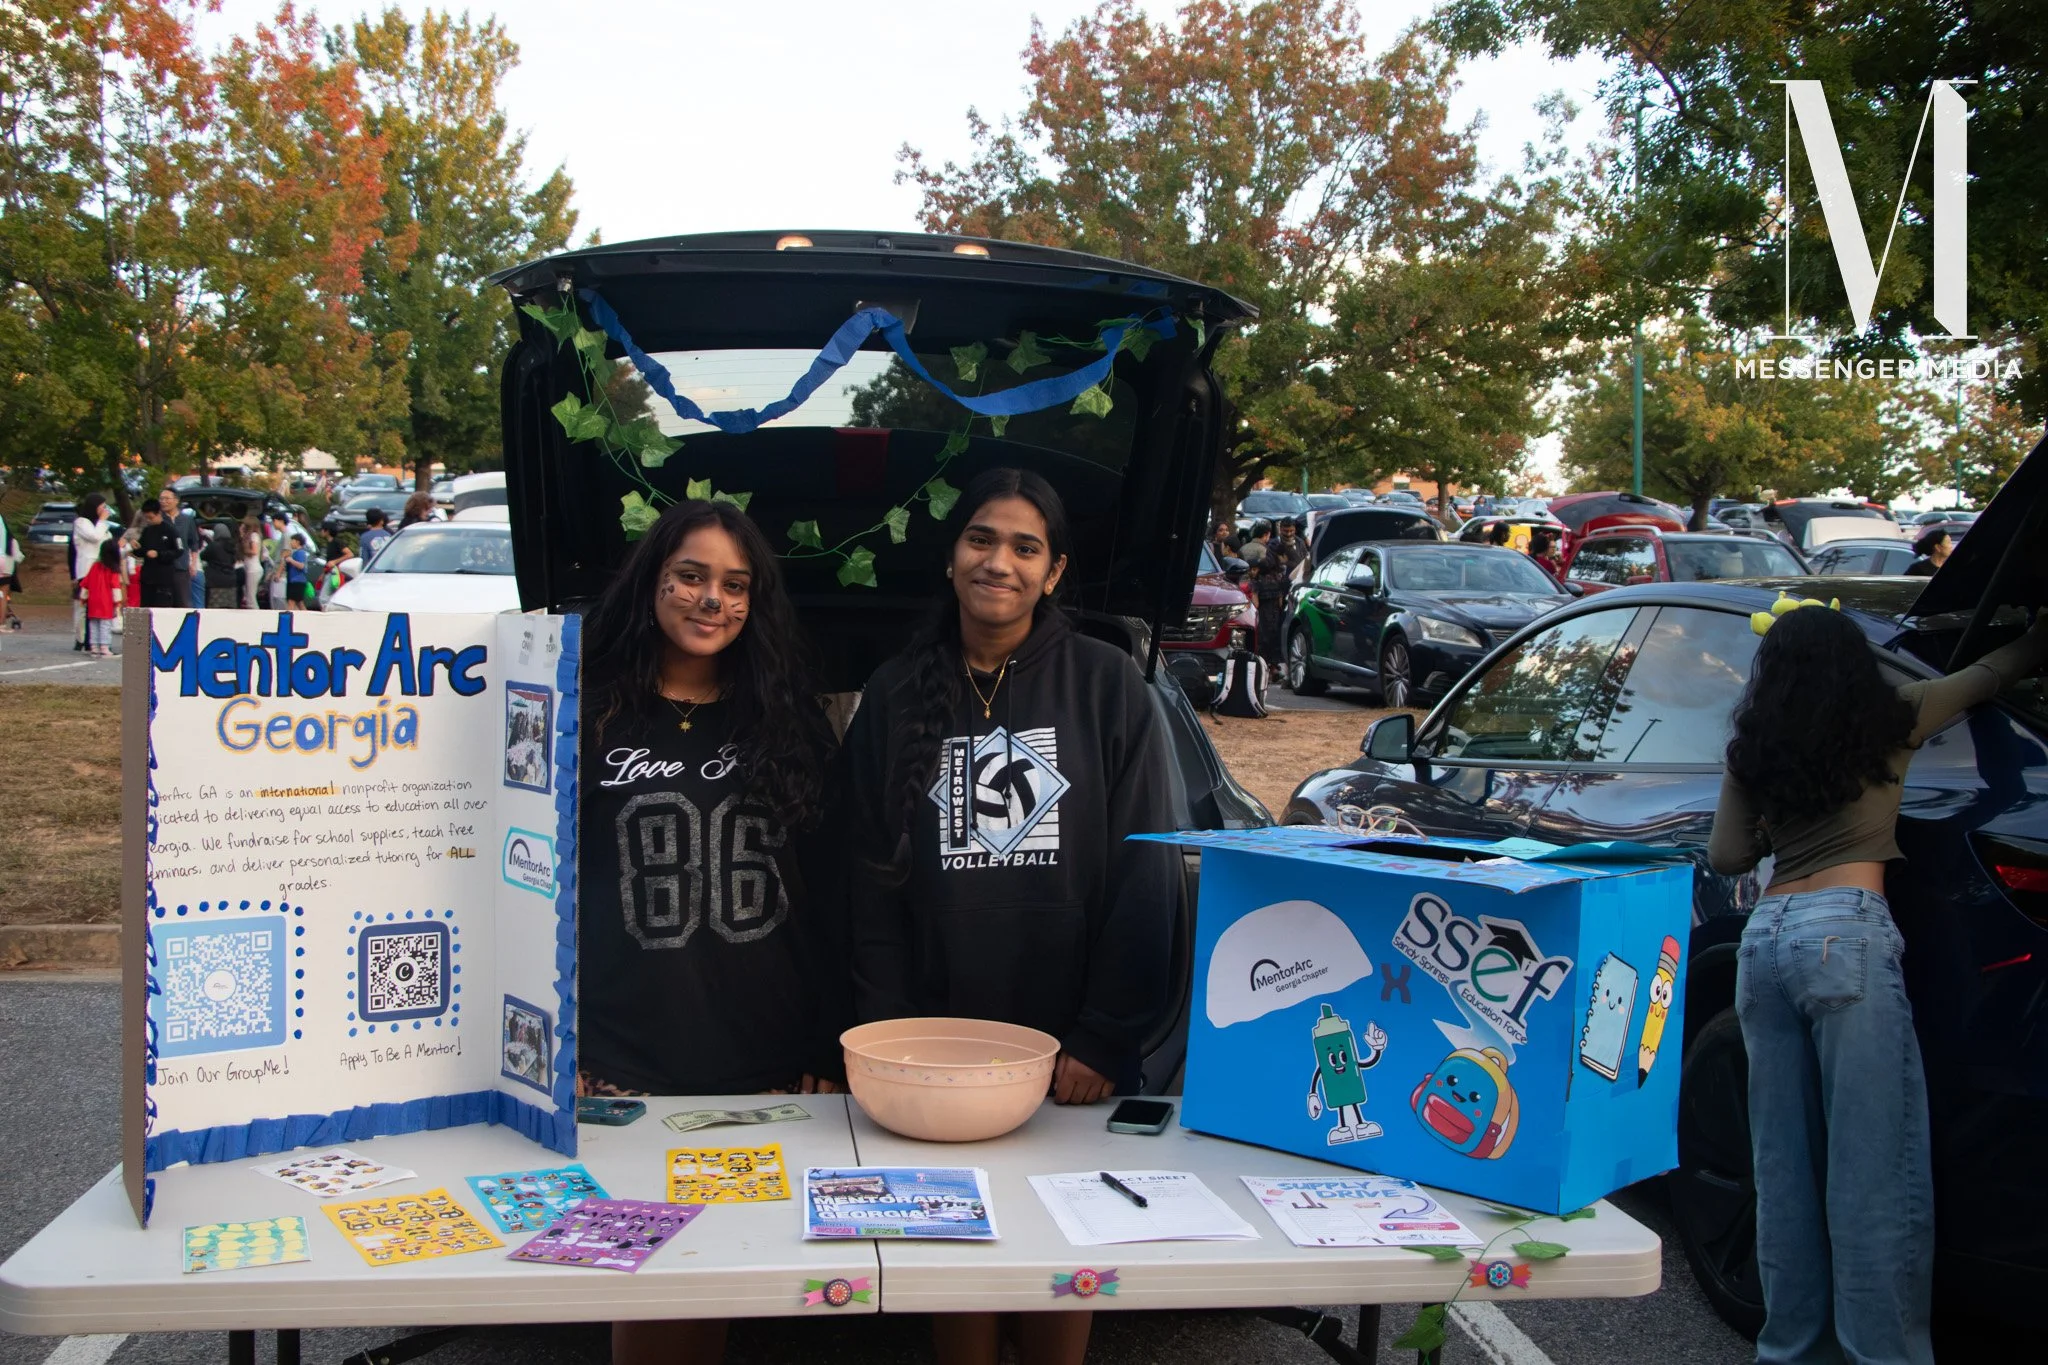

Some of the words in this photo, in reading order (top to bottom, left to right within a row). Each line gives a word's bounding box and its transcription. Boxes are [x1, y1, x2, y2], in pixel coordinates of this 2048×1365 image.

[150, 611, 367, 698] Mentor
[366, 612, 488, 697] Arc
[217, 695, 420, 771] Georgia
[600, 747, 686, 787] Love
[199, 785, 218, 800] GA
[225, 788, 234, 799] is
[239, 789, 254, 798] an
[260, 780, 335, 798] international
[342, 779, 399, 798] nonprofit
[402, 780, 472, 797] organization
[952, 749, 965, 838] METROWEST
[203, 812, 218, 824] to
[224, 806, 285, 823] delivering
[289, 804, 322, 822] equal
[328, 804, 361, 815] access
[366, 800, 380, 813] to
[384, 800, 440, 813] education
[443, 798, 460, 811] all
[463, 800, 488, 811] over
[150, 842, 196, 858] eorgia.
[201, 836, 223, 852] We
[228, 832, 290, 850] fundraise
[293, 829, 312, 843] for
[316, 829, 354, 845] school
[412, 824, 444, 839] teach
[448, 822, 475, 837] free
[149, 865, 202, 880] eminars,
[209, 859, 236, 875] and
[242, 857, 285, 873] deliver
[289, 851, 371, 876] personalized
[375, 851, 420, 868] tutoring
[426, 845, 443, 861] for
[450, 846, 476, 860] ALL
[512, 853, 551, 877] MentorArc
[615, 791, 790, 950] 86
[941, 852, 1059, 871] VOLLEYBALL
[279, 875, 332, 900] grades.
[1254, 958, 1314, 990] MentorArc
[1392, 936, 1420, 962] Sandy
[1419, 955, 1450, 986] Springs
[1275, 978, 1302, 993] Georgia
[1301, 966, 1329, 984] Chapter
[1461, 988, 1503, 1025] Education
[1503, 1021, 1527, 1043] Force
[340, 1052, 369, 1071] Apply
[370, 1049, 384, 1064] To
[386, 1048, 401, 1061] Be
[403, 1045, 413, 1059] A
[416, 1035, 463, 1058] Mentor!
[157, 1066, 190, 1086] Join
[196, 1065, 221, 1083] Our
[1276, 1181, 1372, 1192] SUPPLY
[1315, 1189, 1403, 1200] DRIVE
[815, 1204, 841, 1212] IN
